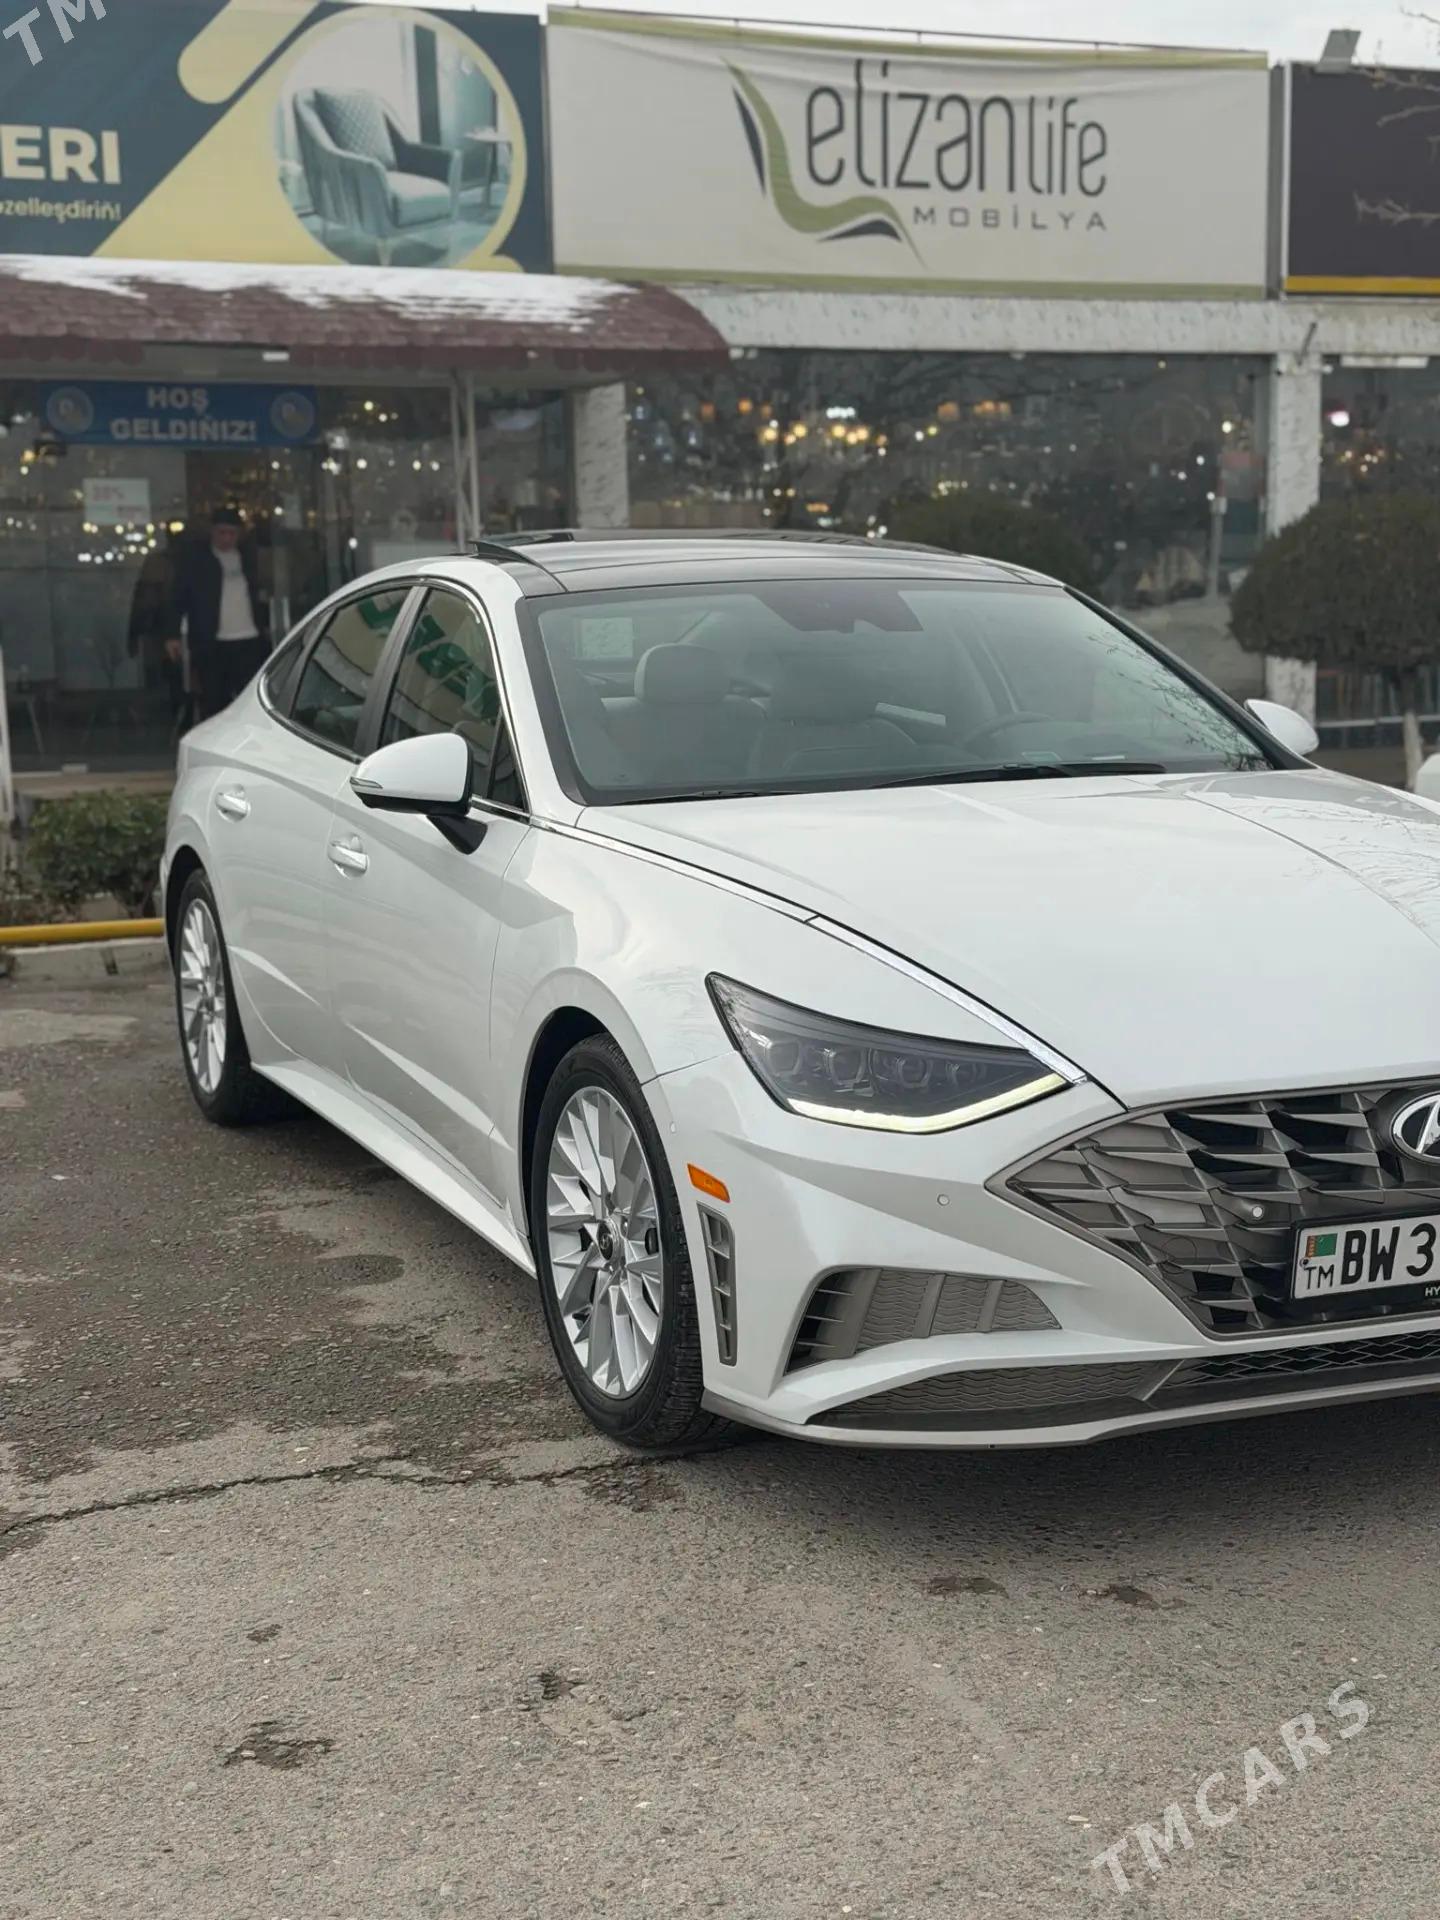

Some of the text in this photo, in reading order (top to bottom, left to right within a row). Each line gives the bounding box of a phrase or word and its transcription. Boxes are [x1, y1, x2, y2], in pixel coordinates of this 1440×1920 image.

[1, 125, 121, 185] ERI
[913, 204, 1107, 231] MOBİLYA
[147, 386, 209, 415] HOŞ
[1304, 1264, 1335, 1290] TM
[1340, 1226, 1400, 1285] BW
